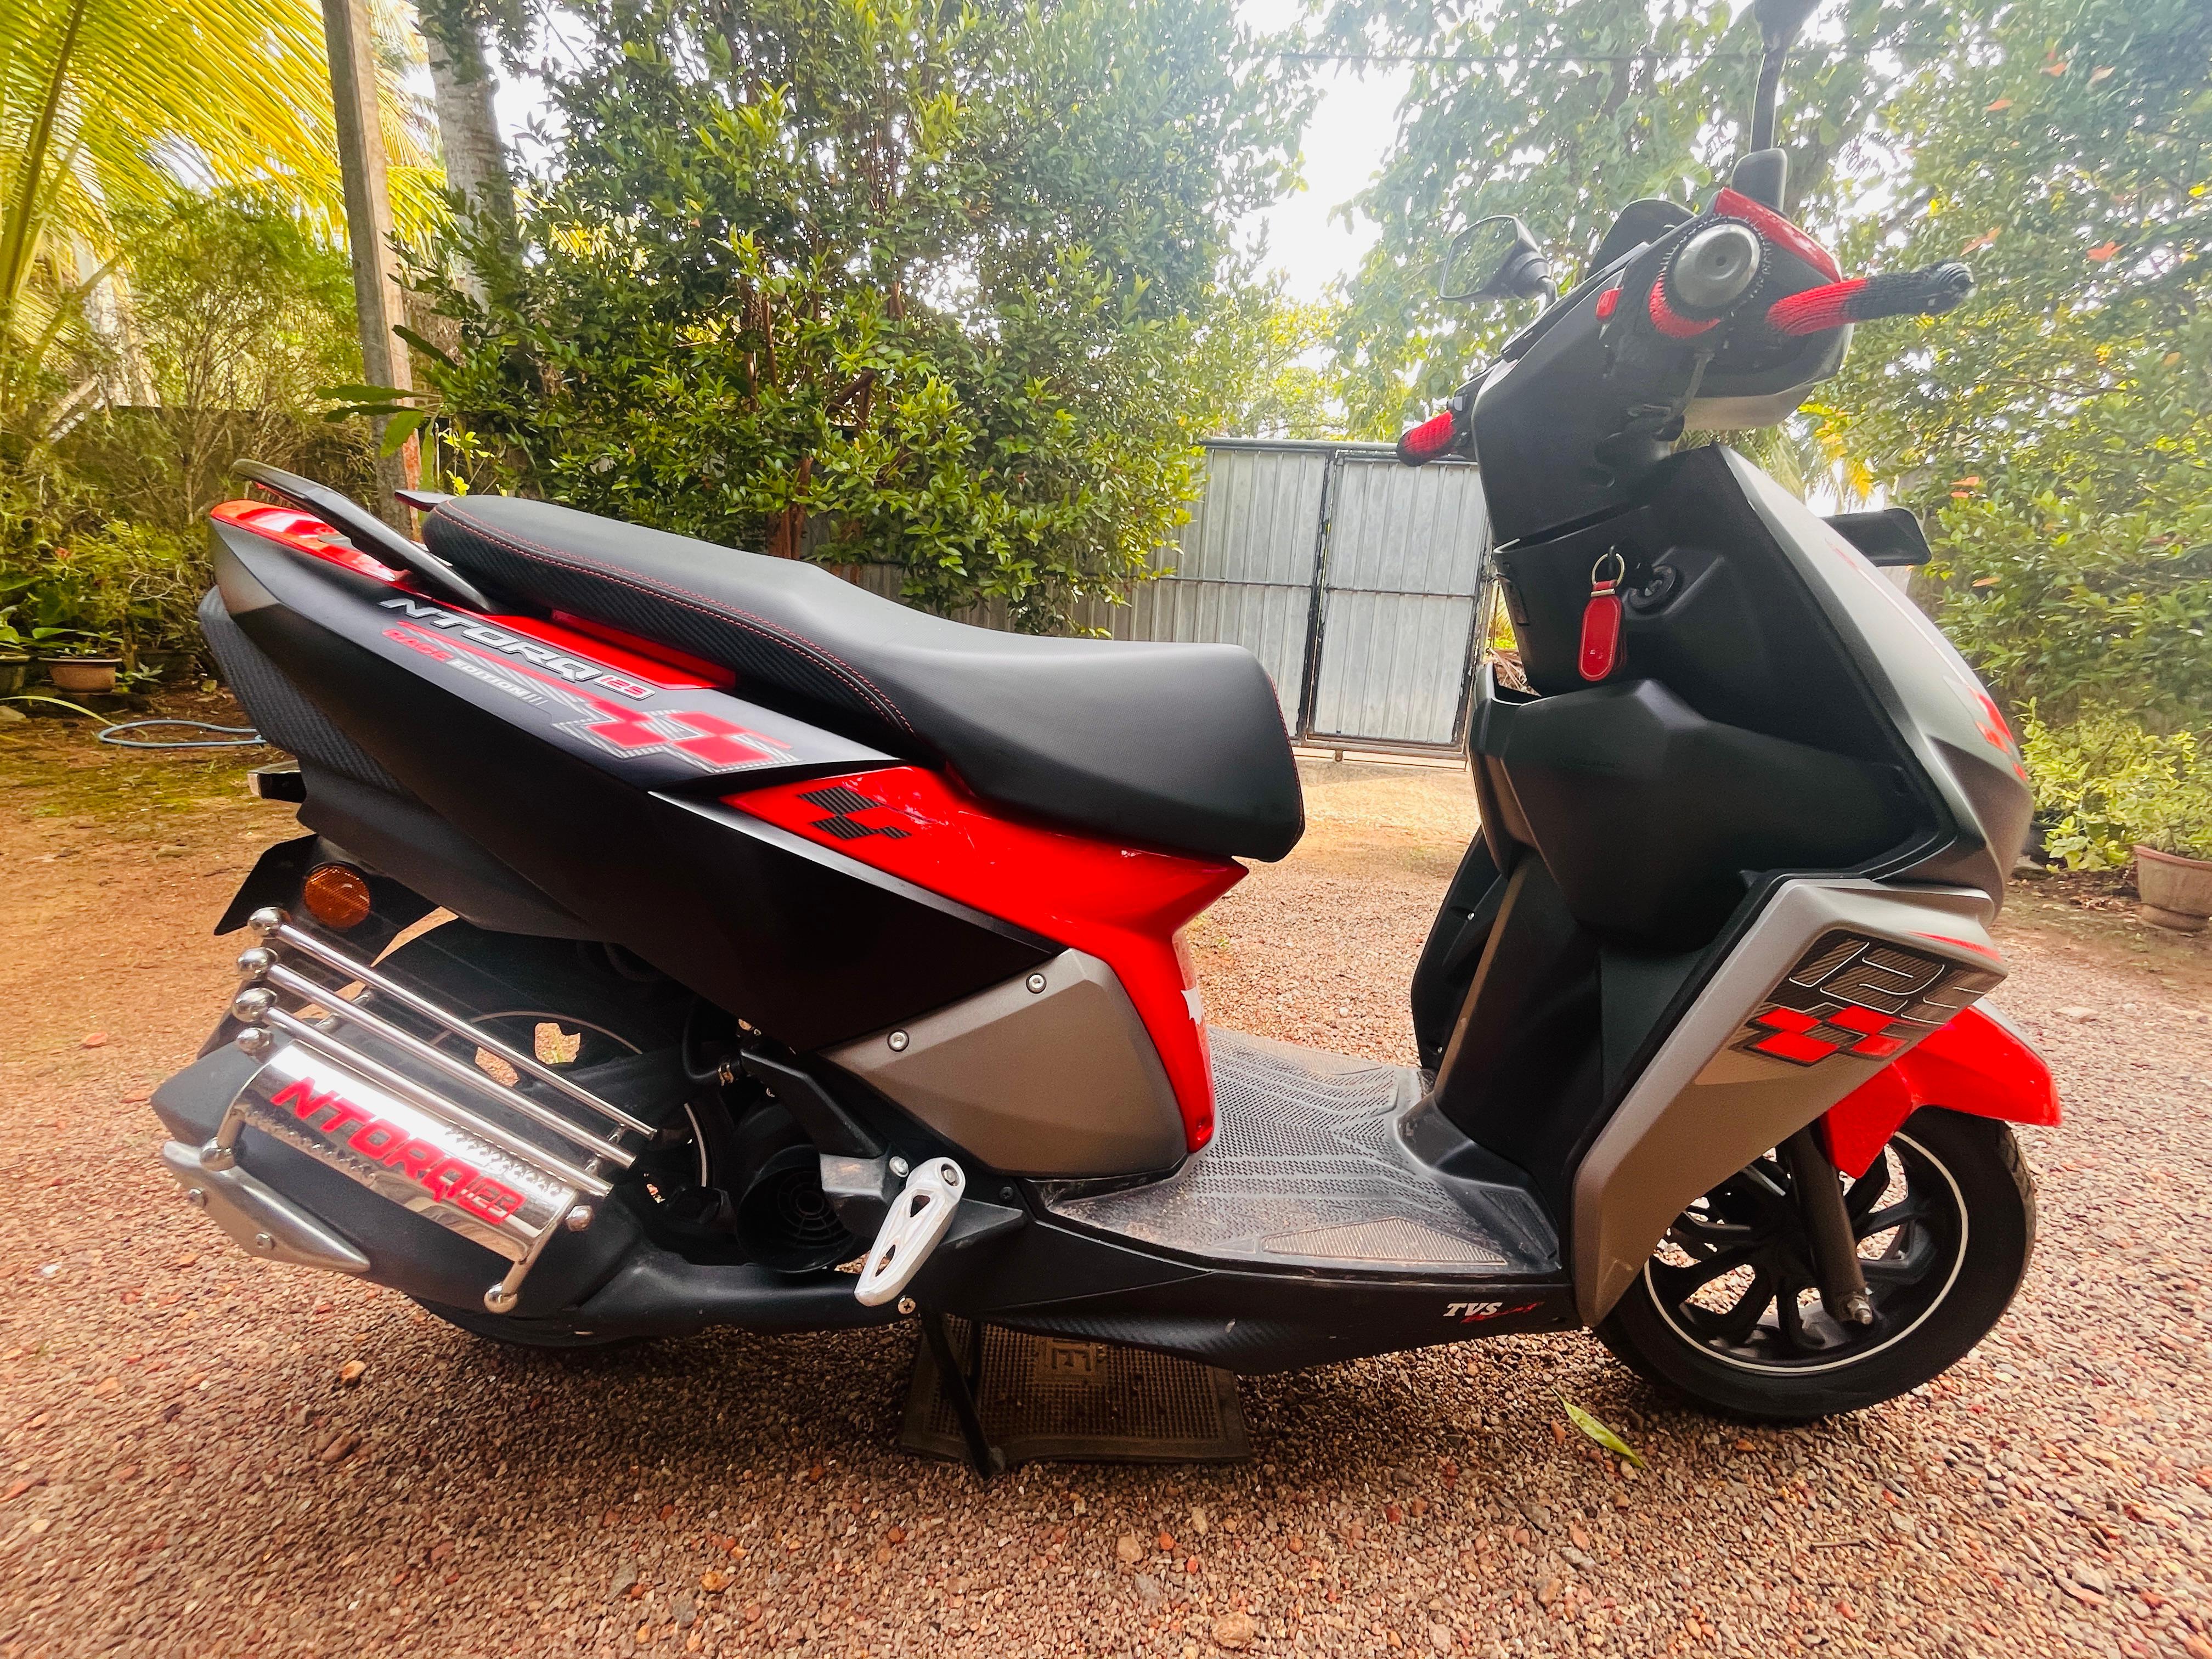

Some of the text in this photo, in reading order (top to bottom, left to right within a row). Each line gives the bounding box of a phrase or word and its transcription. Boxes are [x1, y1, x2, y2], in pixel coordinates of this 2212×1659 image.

[379, 598, 651, 698] NTORQ 125
[382, 628, 528, 702] RACE EDITION
[269, 1076, 481, 1204] NTORQ
[1443, 1302, 1503, 1317] TVS
